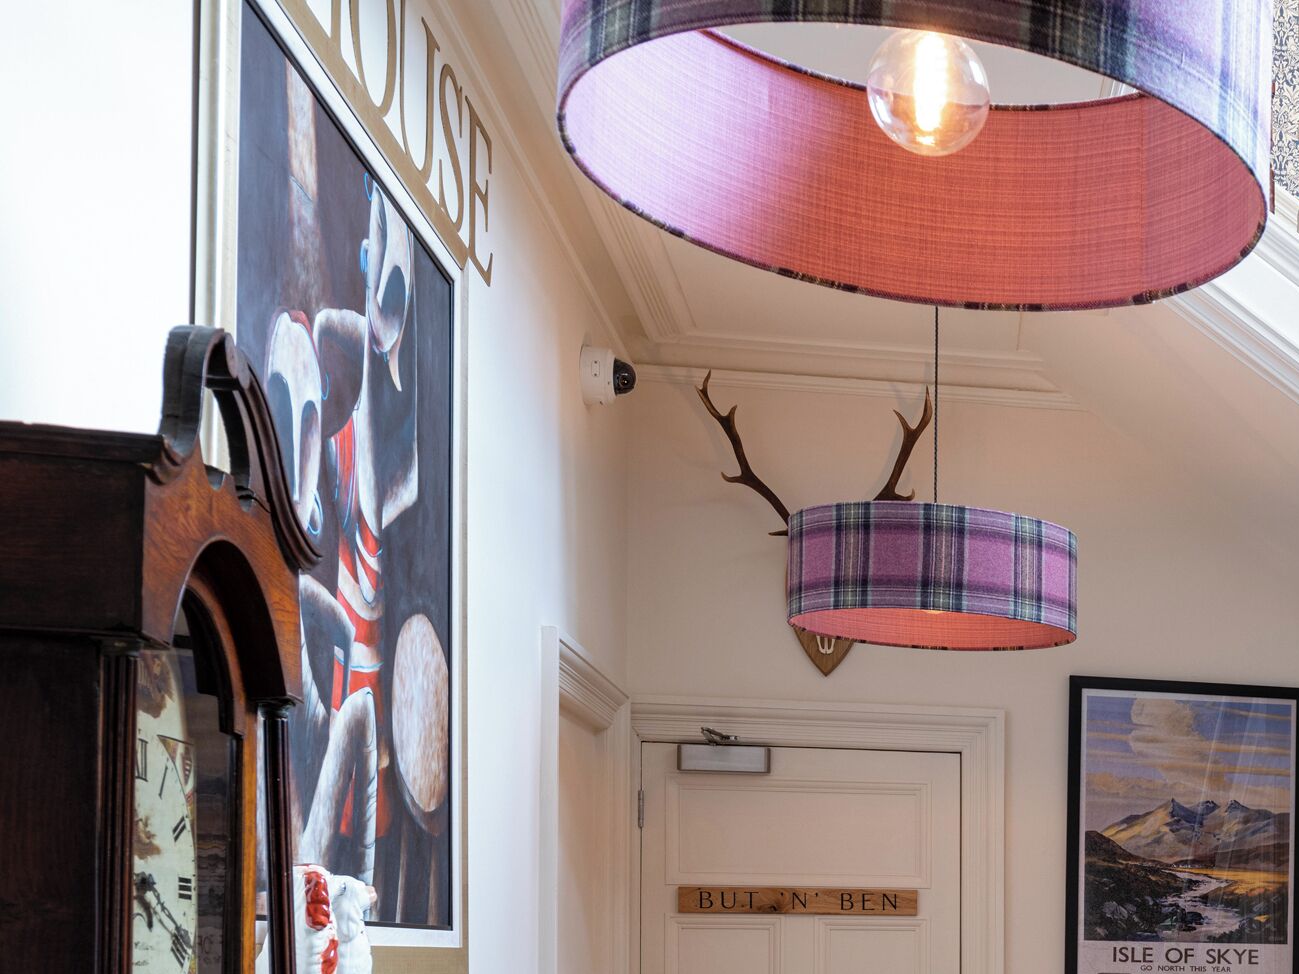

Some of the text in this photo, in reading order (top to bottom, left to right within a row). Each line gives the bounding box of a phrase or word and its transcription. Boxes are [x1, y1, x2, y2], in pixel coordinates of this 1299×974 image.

[330, 0, 493, 287] OUSE
[699, 891, 760, 909] BUT
[840, 892, 898, 911] BEN
[1112, 946, 1259, 965] ISLE OF SKYE
